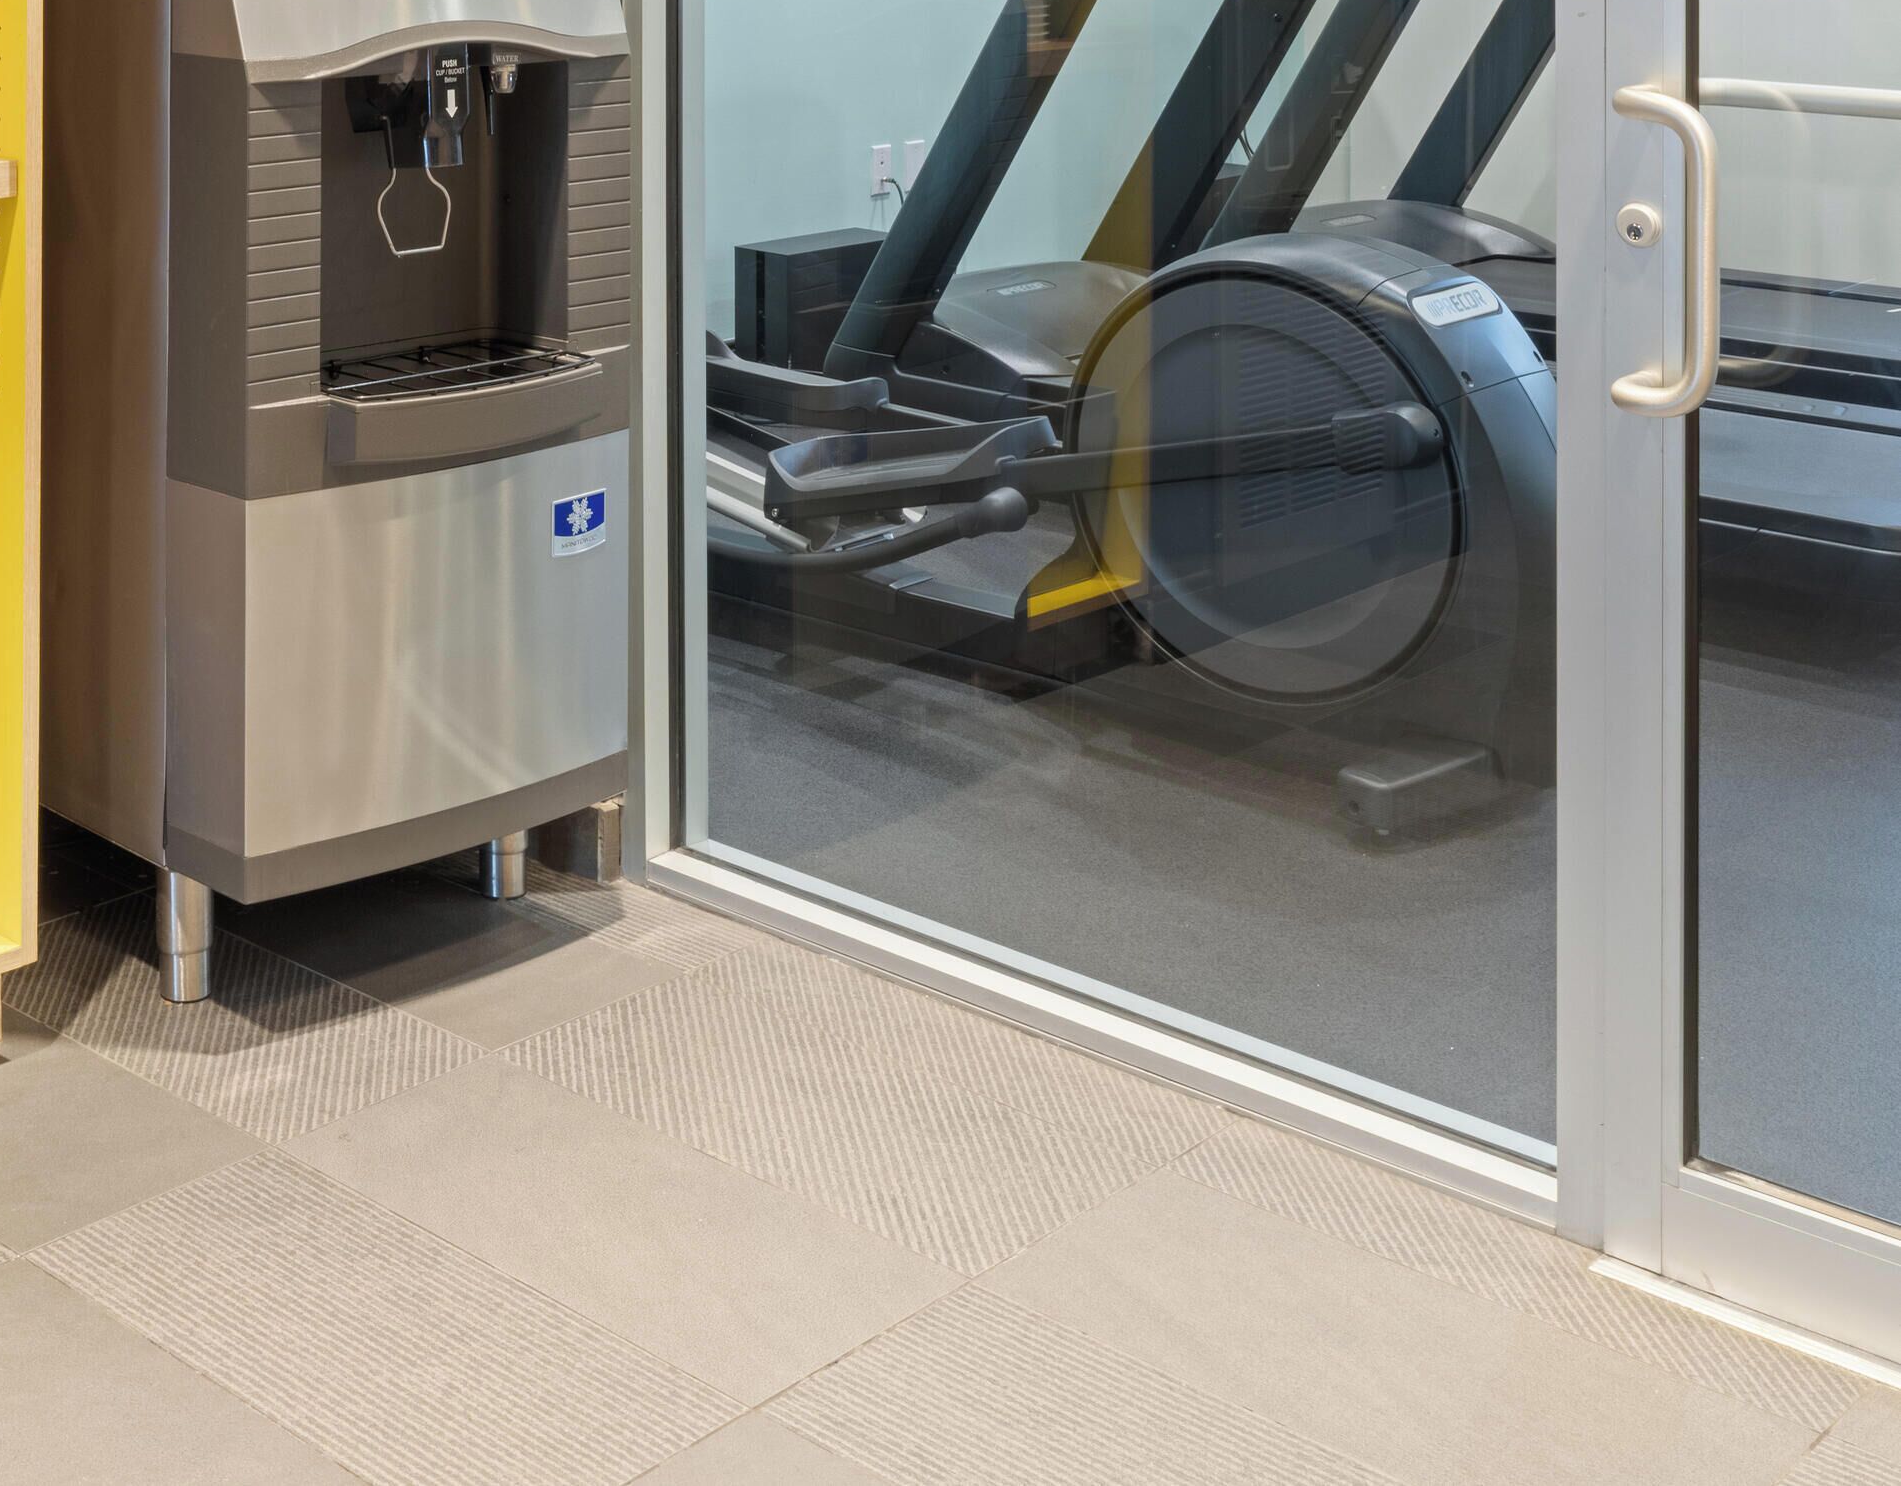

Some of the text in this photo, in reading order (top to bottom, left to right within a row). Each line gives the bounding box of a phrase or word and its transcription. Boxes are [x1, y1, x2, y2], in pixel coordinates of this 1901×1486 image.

[496, 55, 519, 63] WATER
[442, 59, 458, 68] PUSH
[448, 67, 465, 75] BUCKET
[1430, 289, 1487, 318] PRECOR
